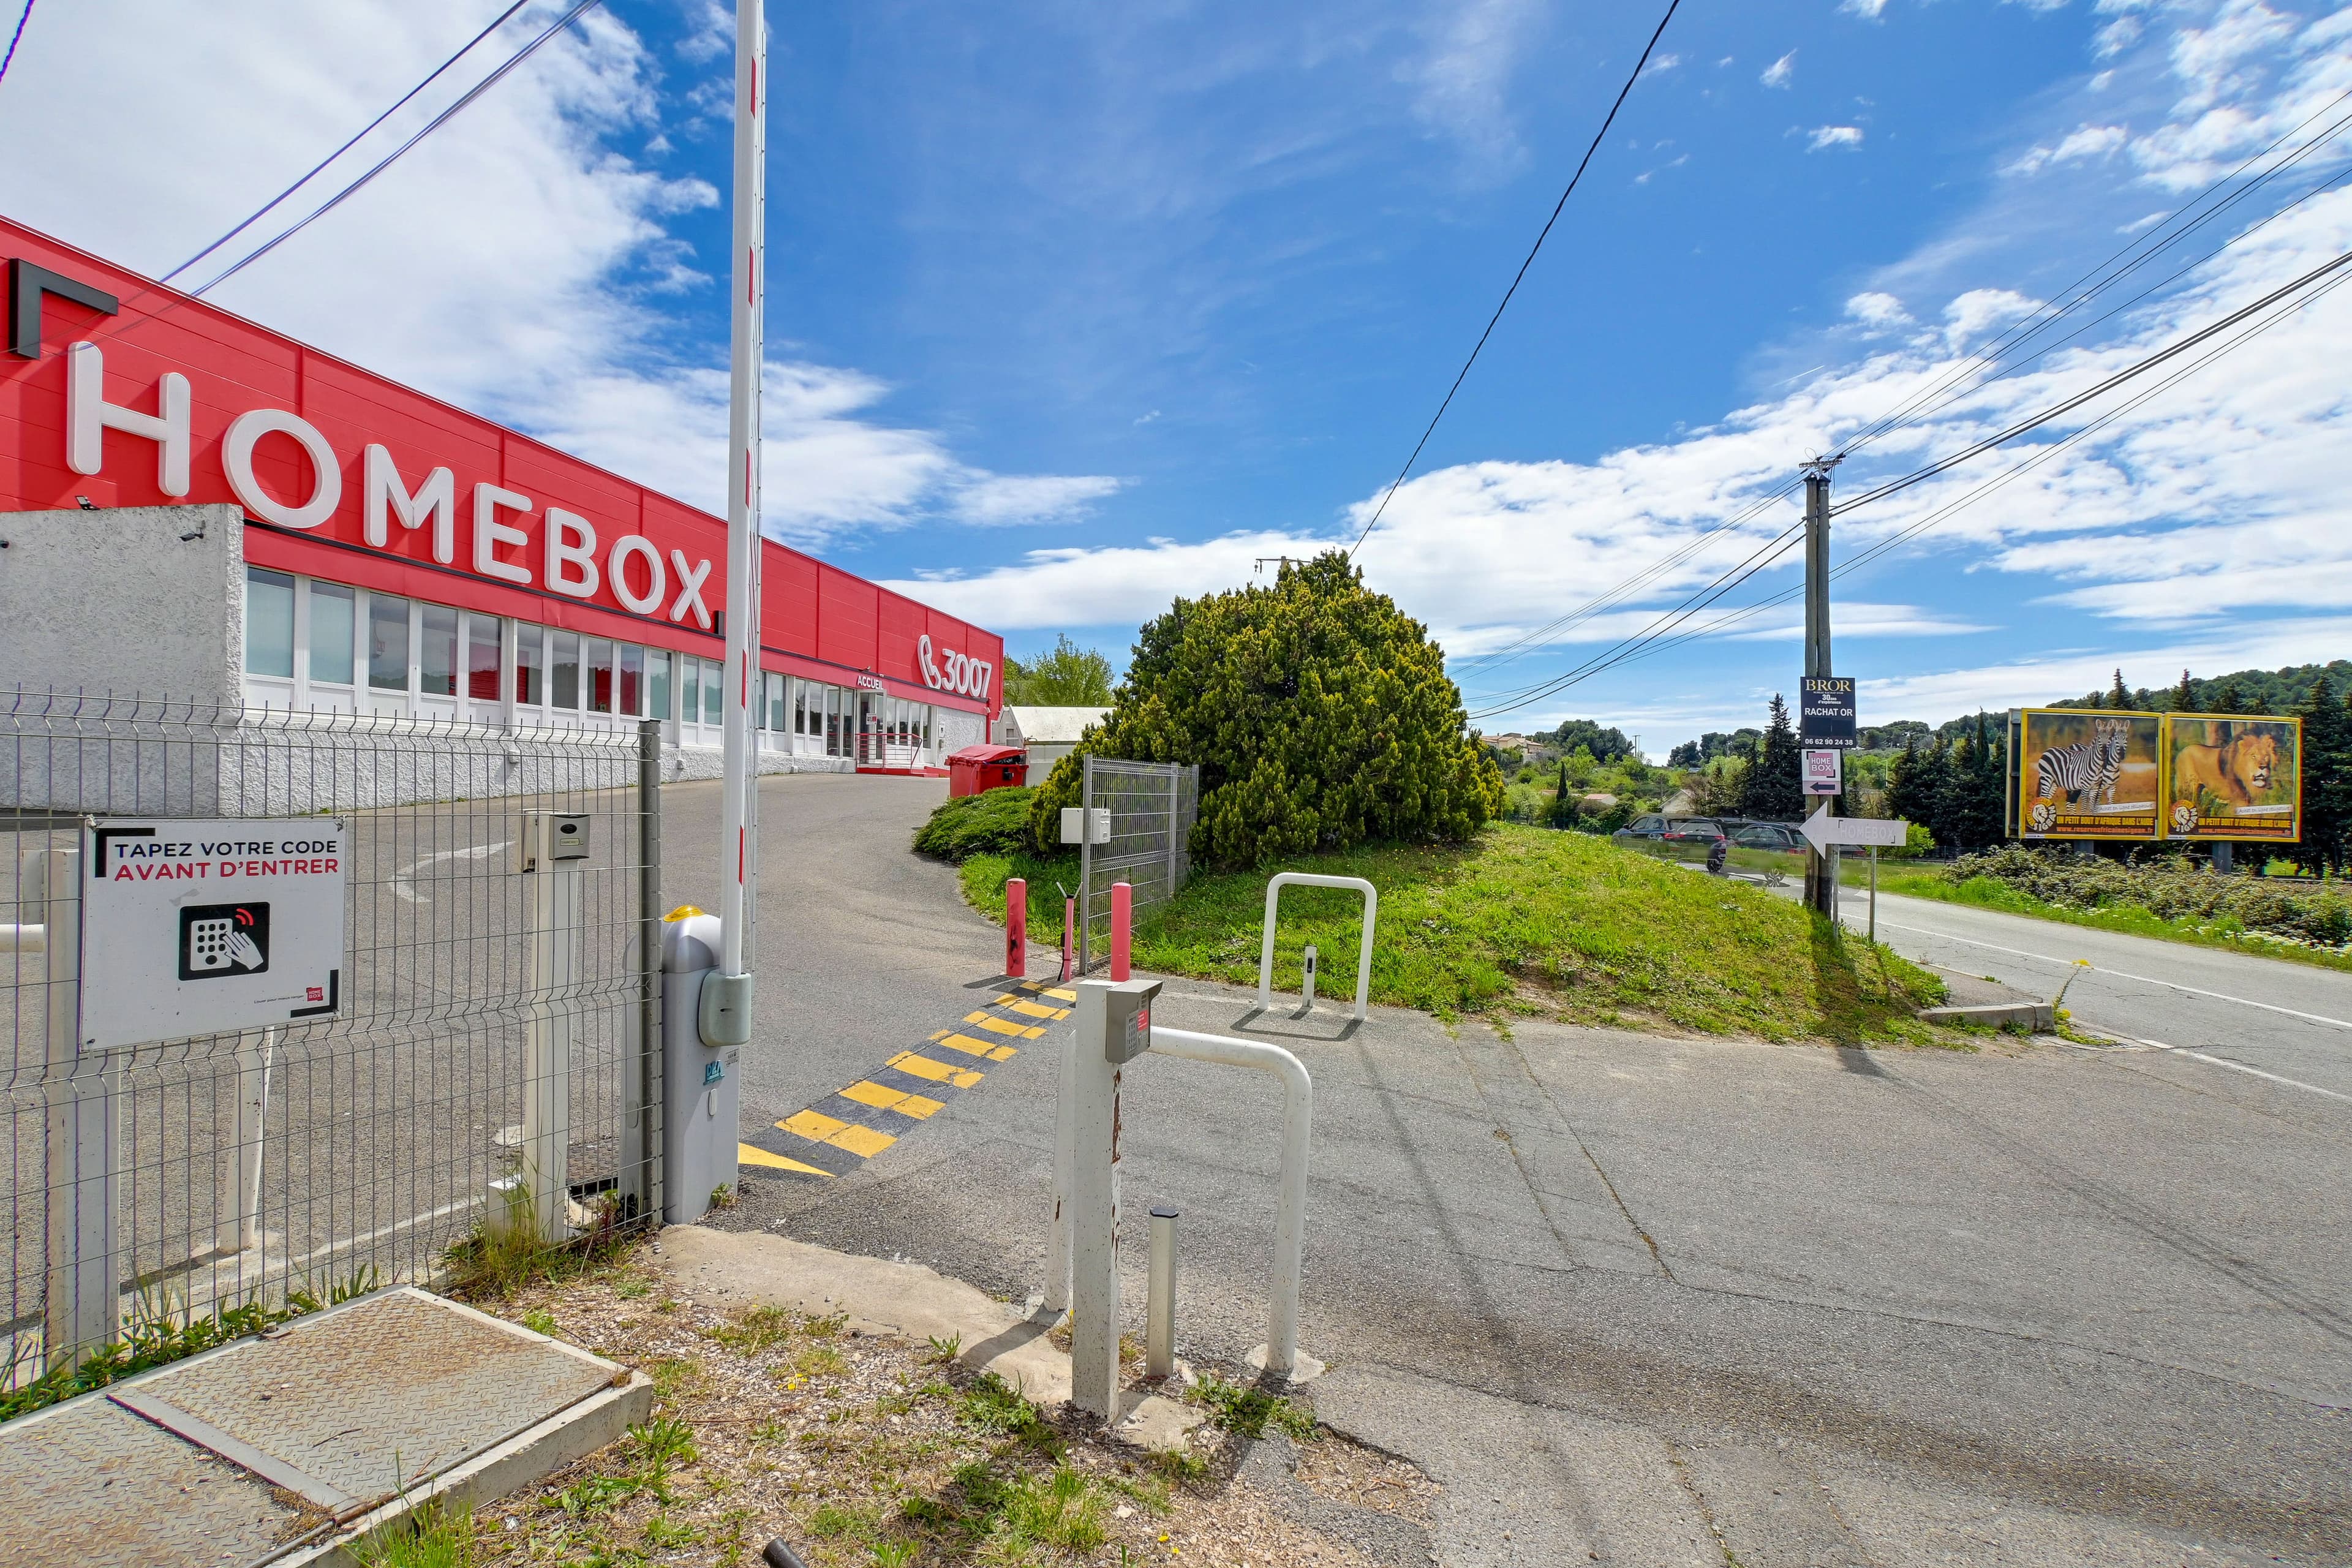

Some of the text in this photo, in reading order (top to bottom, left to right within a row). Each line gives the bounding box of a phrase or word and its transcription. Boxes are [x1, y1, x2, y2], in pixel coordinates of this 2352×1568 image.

[67, 341, 711, 629] HOMEBOX
[941, 648, 992, 697] 3007
[858, 675, 884, 690] ACCUEIL
[1805, 679, 1852, 692] BROR
[1840, 824, 1894, 840] HOMEBOX
[115, 840, 337, 858] TAPEZ VOTRE CODE
[115, 858, 338, 881] AVANT D'ENTRER
